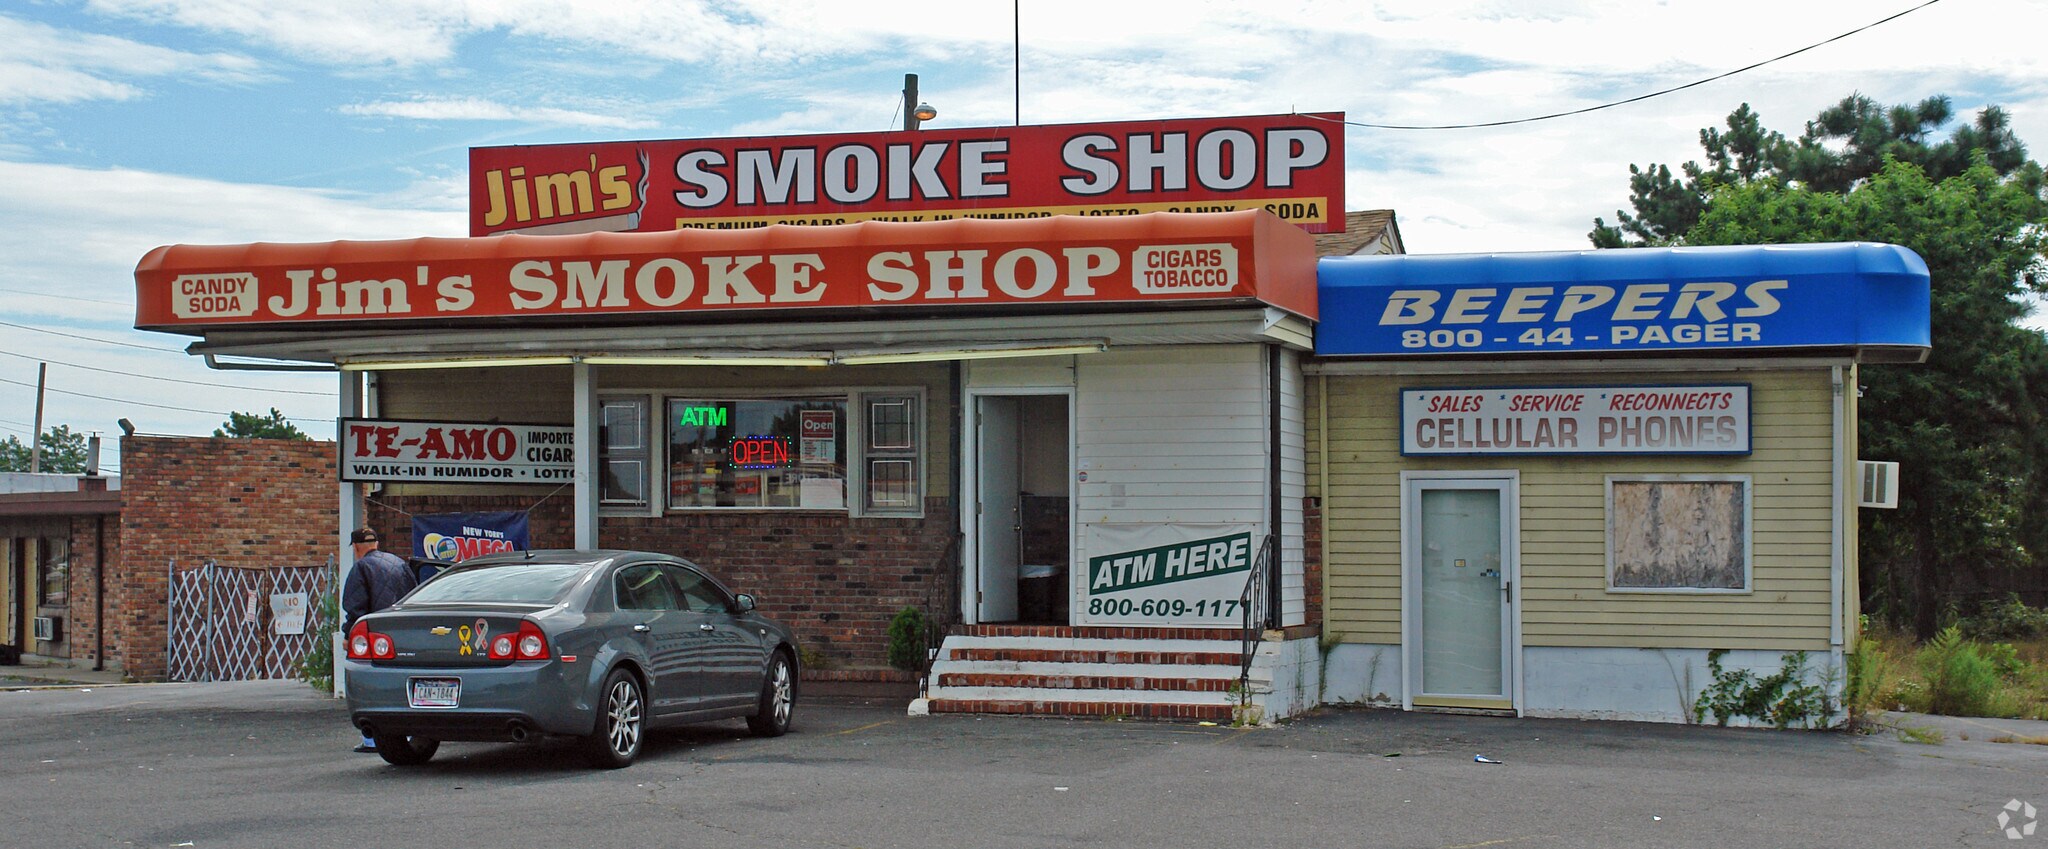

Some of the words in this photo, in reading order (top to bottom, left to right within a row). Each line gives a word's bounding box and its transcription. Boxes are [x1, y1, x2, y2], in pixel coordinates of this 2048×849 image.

[485, 153, 632, 227] Jim's
[674, 140, 1010, 207] SMOKE
[1061, 127, 1329, 195] SHOP
[1264, 203, 1319, 219] SODA
[1147, 249, 1222, 269] CIGARS
[181, 277, 249, 296] CANDY
[267, 266, 475, 316] Jim's
[509, 254, 827, 310] SMOKE
[866, 246, 1121, 302] SHOP
[1143, 268, 1228, 288] TOBACCO
[189, 295, 242, 314] SODA
[1379, 280, 1789, 327] BEEPERS
[1402, 329, 1483, 348] 800
[1518, 328, 1574, 347] 44
[1612, 323, 1761, 344] PAGER
[1428, 395, 1483, 412] SALES
[1509, 394, 1584, 412] SERVICE
[1609, 392, 1733, 411] RECONNECTS
[680, 406, 727, 426] ATM
[804, 419, 834, 431] Open
[528, 431, 574, 445] IMPORTE
[1416, 417, 1578, 448] CELLULAR
[1598, 416, 1737, 448] PHONES
[350, 425, 517, 461] TE-AMO
[733, 440, 787, 464] OPEN
[527, 447, 575, 463] CIGAR
[353, 464, 426, 477] WALK-IN
[434, 466, 513, 478] HUMIDOR
[462, 526, 482, 537] NEW
[484, 529, 504, 539] YORK'S
[453, 537, 515, 562] MEGA
[1092, 552, 1158, 590] ATM
[1165, 537, 1249, 578] HERE
